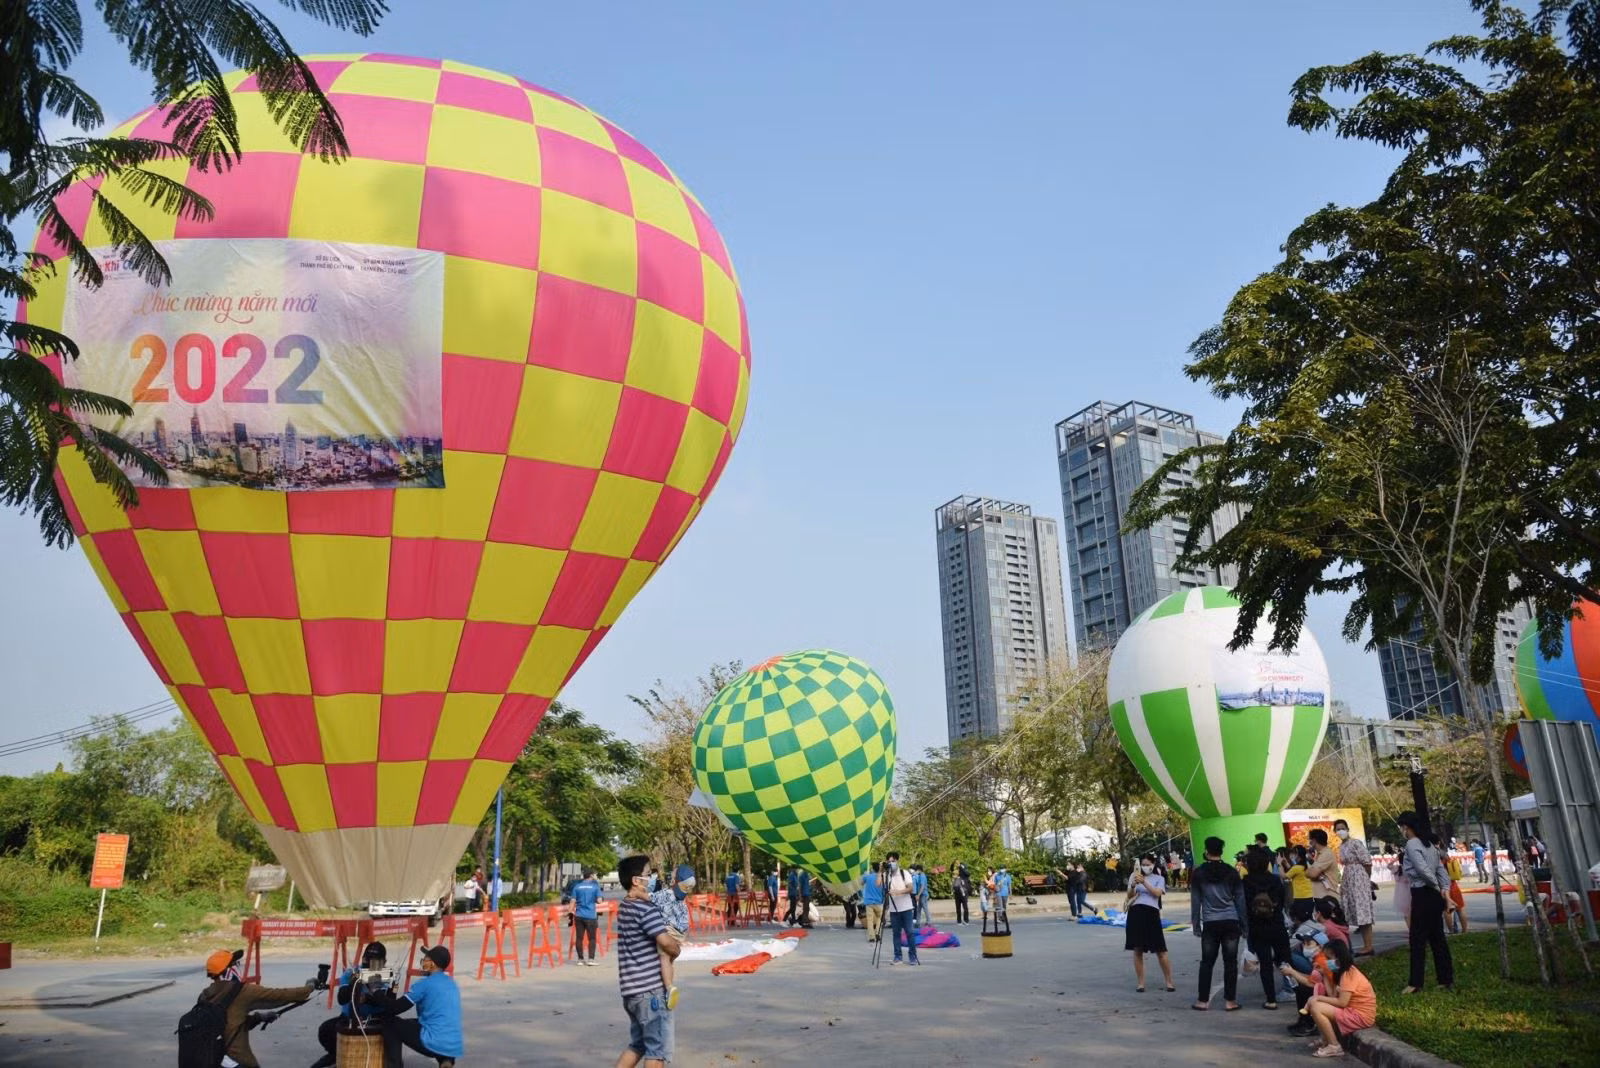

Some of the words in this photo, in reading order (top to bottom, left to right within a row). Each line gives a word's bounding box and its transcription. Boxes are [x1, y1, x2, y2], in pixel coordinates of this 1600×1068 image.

[133, 288, 180, 315] Chúc
[184, 291, 254, 324] mừng
[237, 289, 278, 312] năm
[281, 292, 318, 313] mới
[129, 332, 324, 405] 2022
